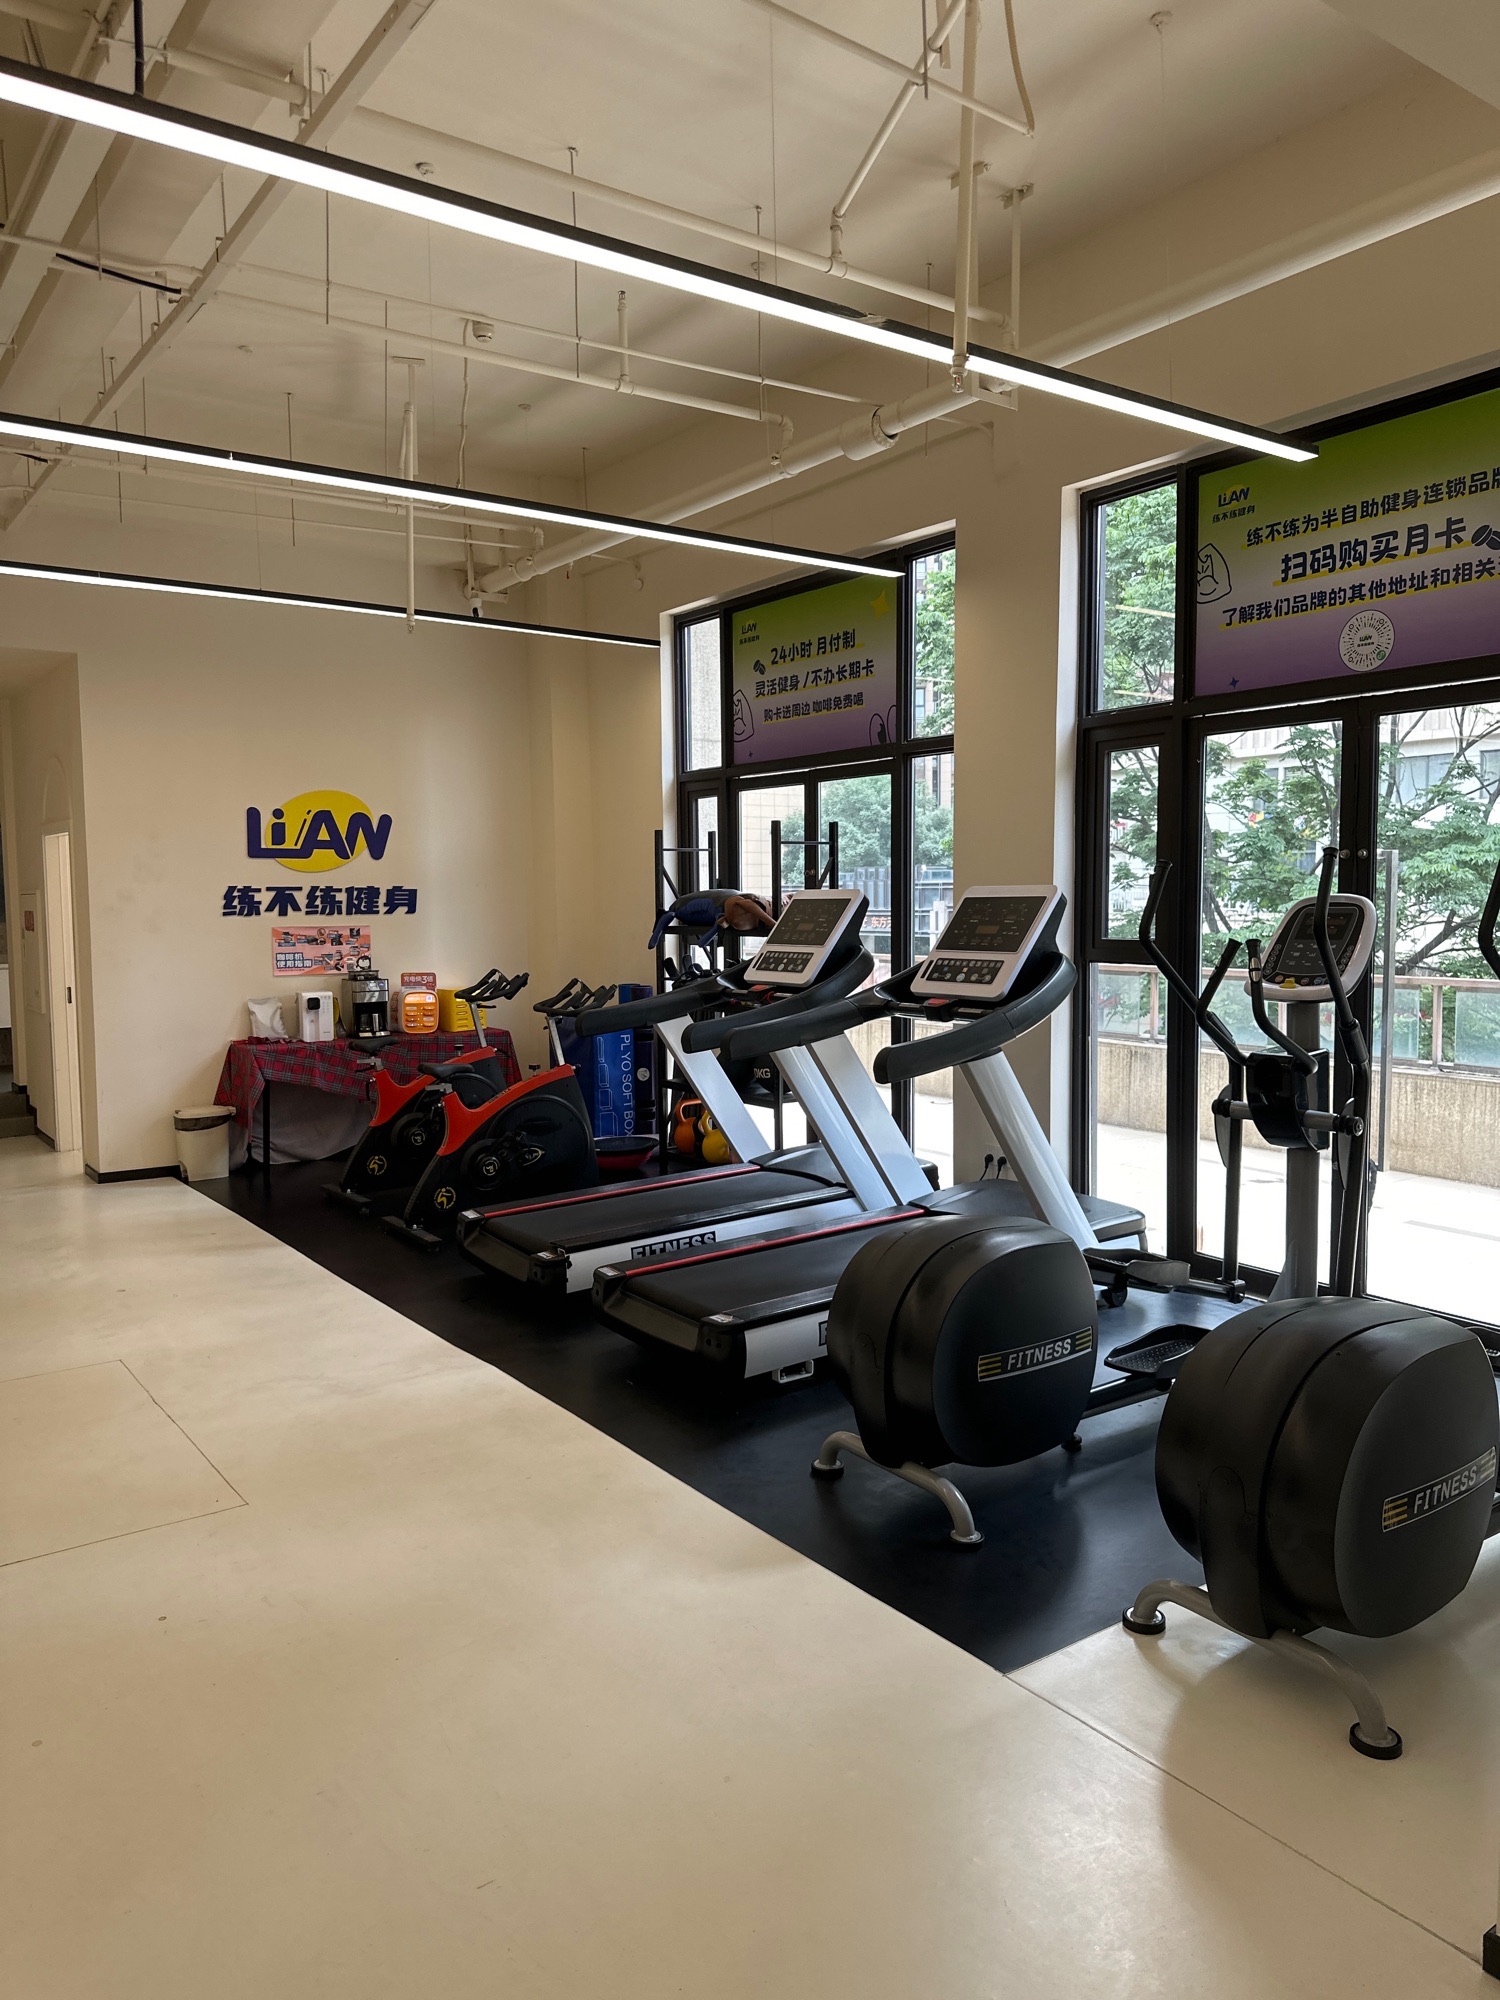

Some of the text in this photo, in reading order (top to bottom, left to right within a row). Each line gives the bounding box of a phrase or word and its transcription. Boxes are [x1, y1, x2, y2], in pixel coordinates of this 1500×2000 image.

[1212, 505, 1256, 523] 练不练健身
[1281, 516, 1467, 583] 扫码购买月卡
[1222, 555, 1500, 628] 了解我们品牌的其他地址和相关
[771, 628, 856, 665] 24小时 月付制
[763, 691, 864, 723] 购卡送周边 咖啡免费喝
[222, 885, 418, 917] 练不练健身
[621, 1073, 634, 1108] SOFT
[632, 1233, 715, 1260] FITNESS
[1008, 1338, 1072, 1371] FITNESS
[1413, 1466, 1477, 1514] FITNESS
